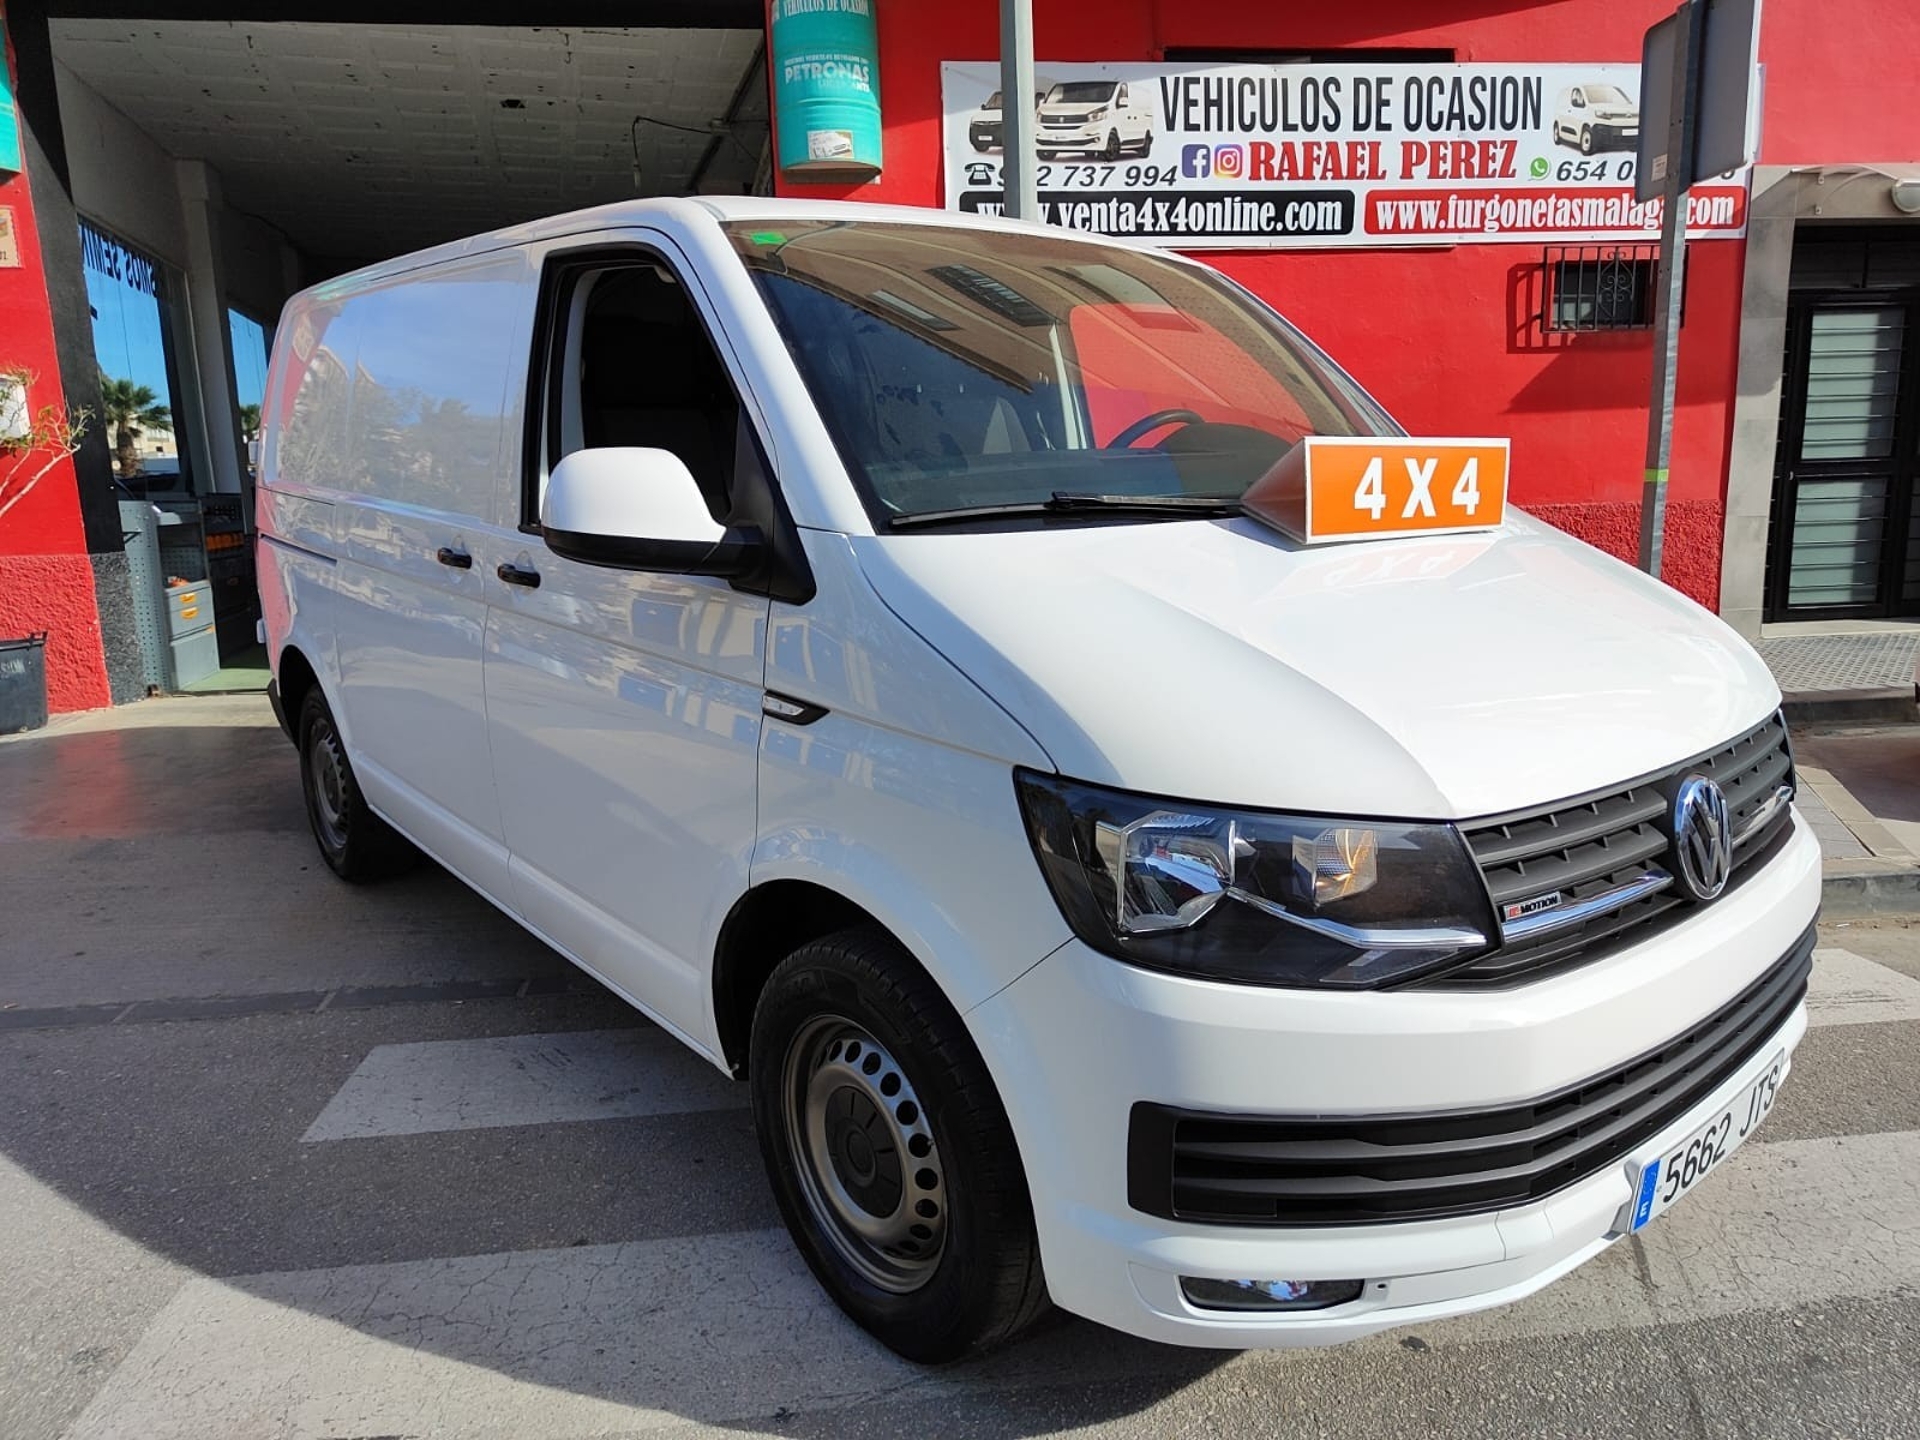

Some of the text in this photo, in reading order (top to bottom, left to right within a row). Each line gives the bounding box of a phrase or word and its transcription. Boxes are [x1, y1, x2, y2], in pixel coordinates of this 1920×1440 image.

[785, 61, 869, 84] PETRONAS
[1160, 76, 1542, 133] VEHICULOS DE OCASION
[1063, 166, 1115, 187] 737
[1124, 165, 1177, 187] 994
[1249, 140, 1517, 181] RAFAEL PEREZ
[1556, 160, 1608, 181] 654
[1376, 193, 1734, 233] www.furgonetasmalagcom
[1354, 457, 1480, 520] 4 X 4
[1663, 1065, 1778, 1202] 5662 JTS
